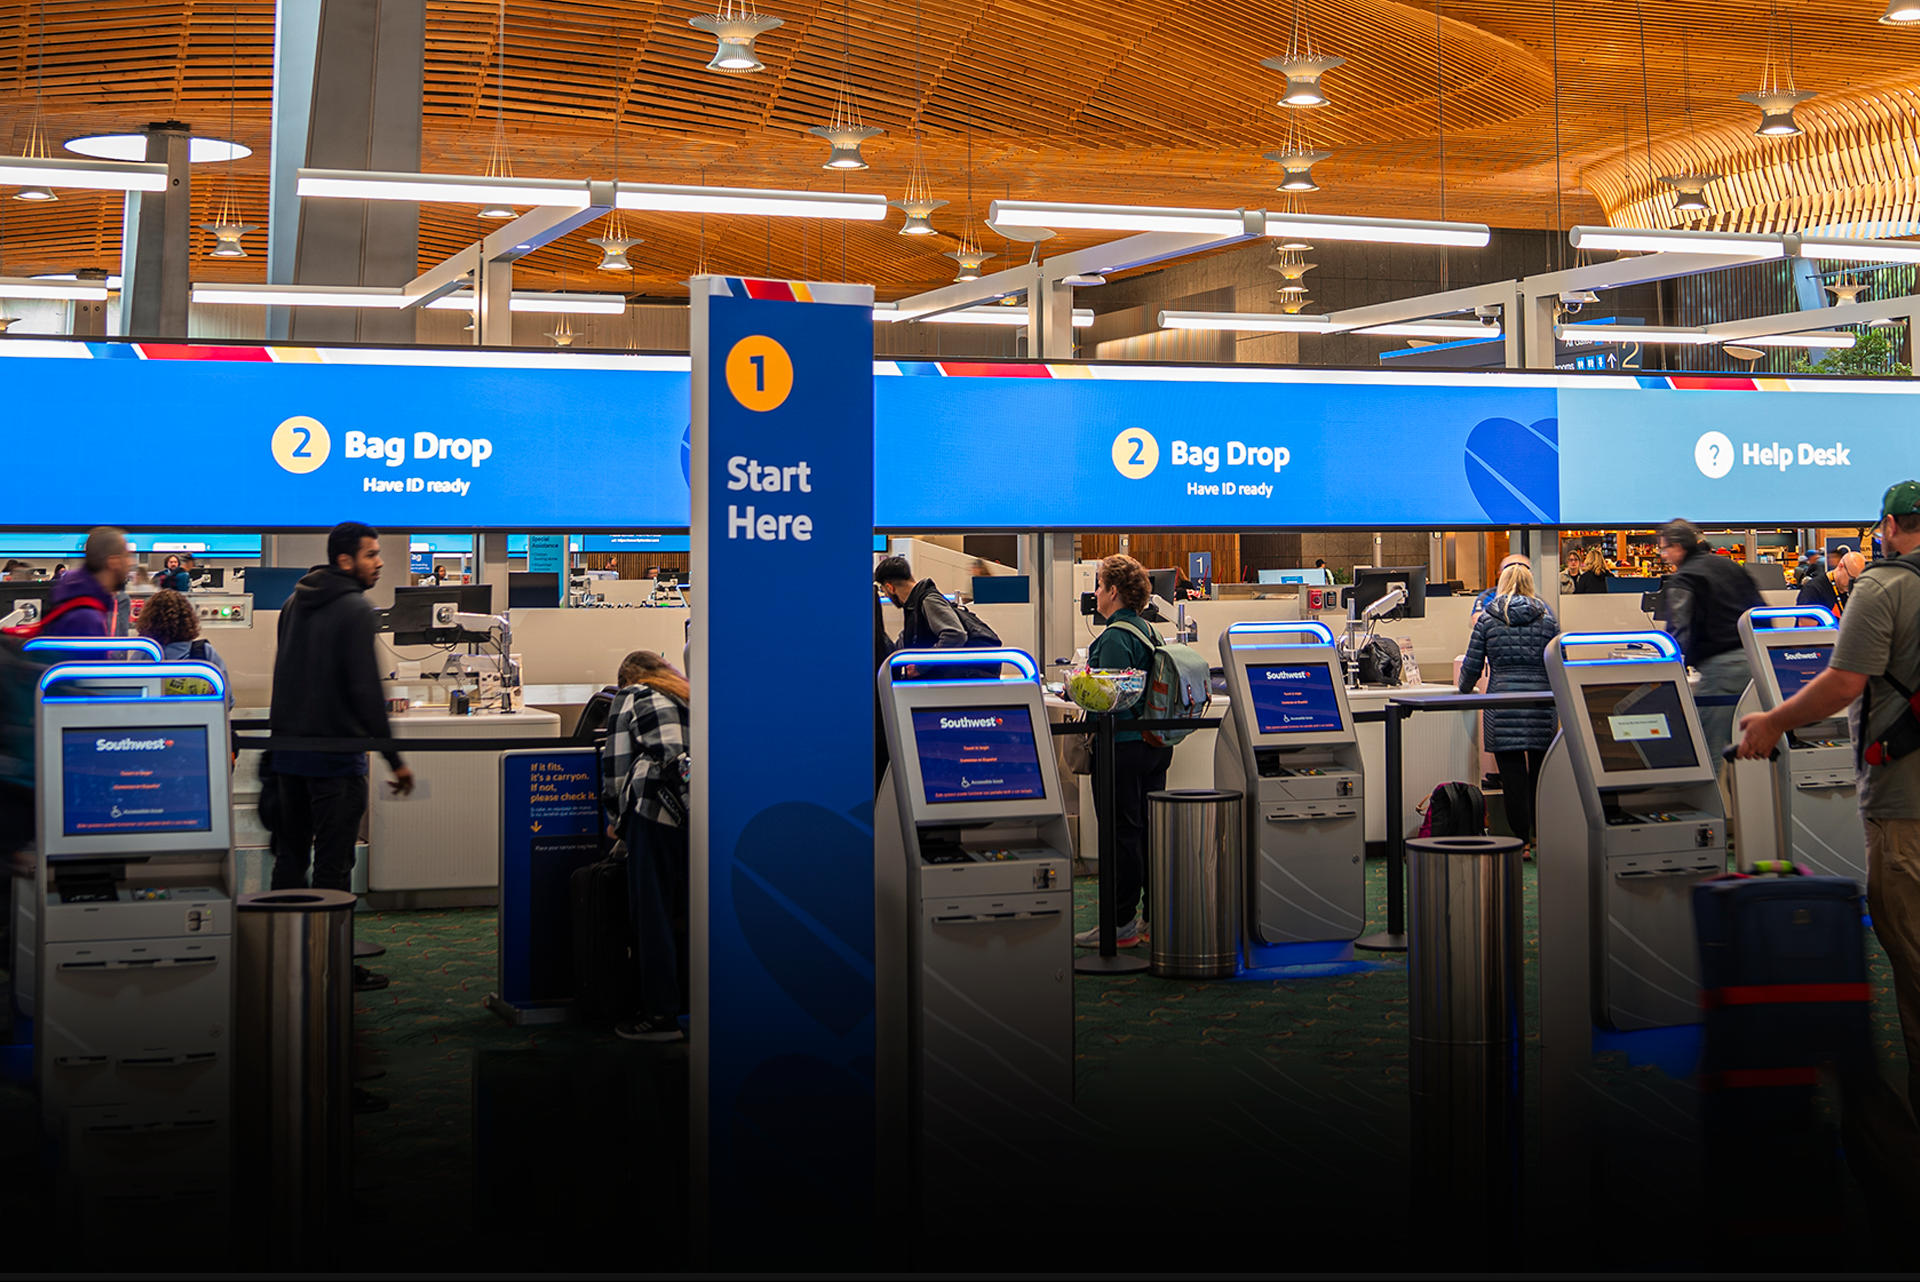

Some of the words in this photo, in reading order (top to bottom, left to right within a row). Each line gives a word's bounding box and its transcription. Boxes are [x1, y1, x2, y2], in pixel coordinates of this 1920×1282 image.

[1622, 340, 1640, 368] 2
[749, 355, 765, 392] 1
[293, 427, 312, 458] 2
[344, 430, 406, 468] Bag
[413, 431, 493, 468] Drop
[1128, 437, 1145, 465] 2
[1171, 440, 1220, 473] Bag
[1226, 440, 1291, 473] Drop
[1709, 444, 1720, 466] ?
[1742, 441, 1794, 469] Help
[1797, 441, 1851, 467] Desk
[727, 455, 812, 493] Start
[363, 477, 405, 493] Have
[407, 477, 425, 493] ID
[427, 477, 471, 498] ready
[1187, 482, 1220, 496] Have
[1221, 482, 1237, 496] ID
[1239, 482, 1274, 499] ready
[728, 504, 813, 541] Here
[1196, 556, 1203, 574] 1
[1265, 670, 1306, 680] Southwest
[940, 716, 997, 729] Southwest
[96, 737, 166, 752] Southwest
[530, 763, 538, 772] If
[539, 763, 546, 772] it
[547, 762, 565, 772] fits,
[530, 773, 544, 782] it's
[530, 783, 538, 792] If
[539, 784, 557, 792] not,
[530, 793, 559, 804] please
[560, 791, 587, 802] check
